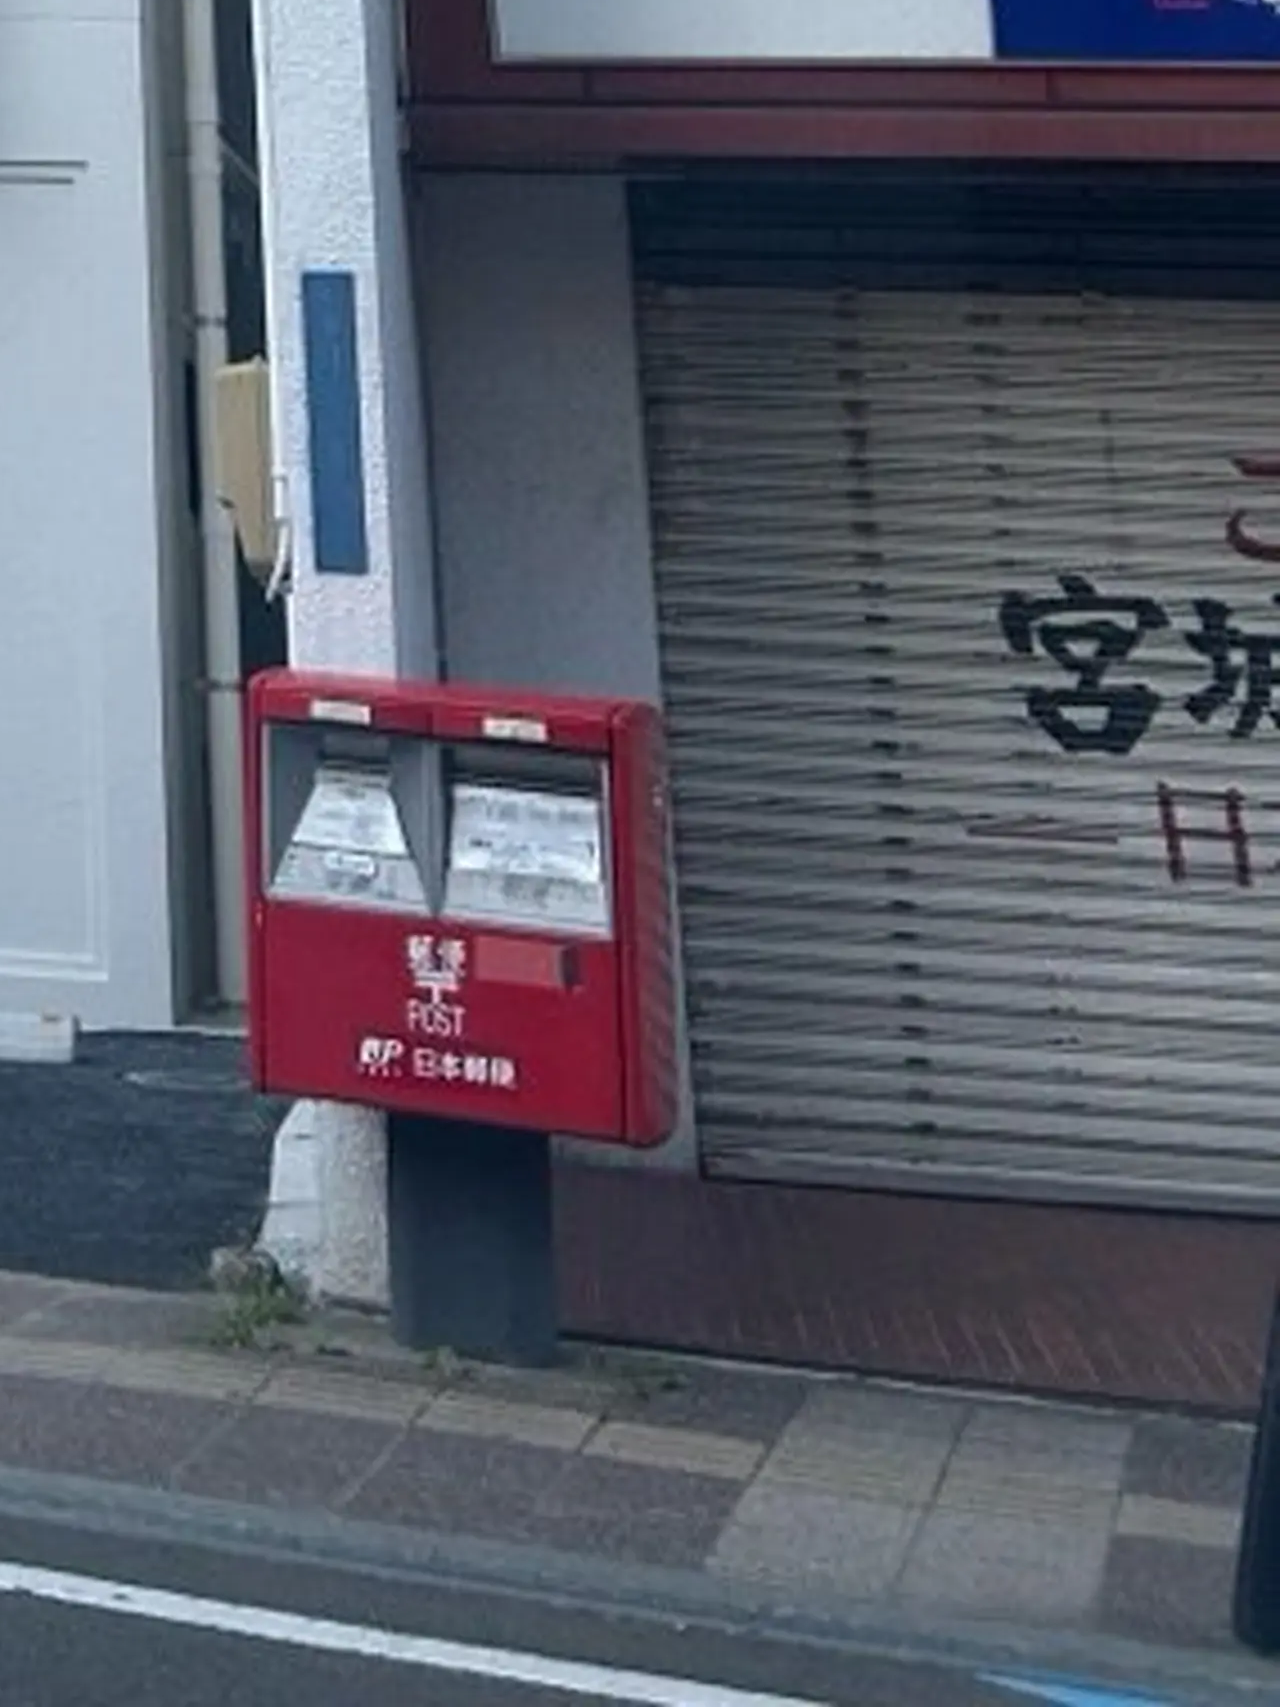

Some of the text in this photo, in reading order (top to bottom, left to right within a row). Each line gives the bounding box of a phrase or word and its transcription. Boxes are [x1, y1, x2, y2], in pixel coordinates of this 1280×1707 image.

[406, 997, 467, 1036] POST
[412, 1047, 517, 1090] 日本郵便
